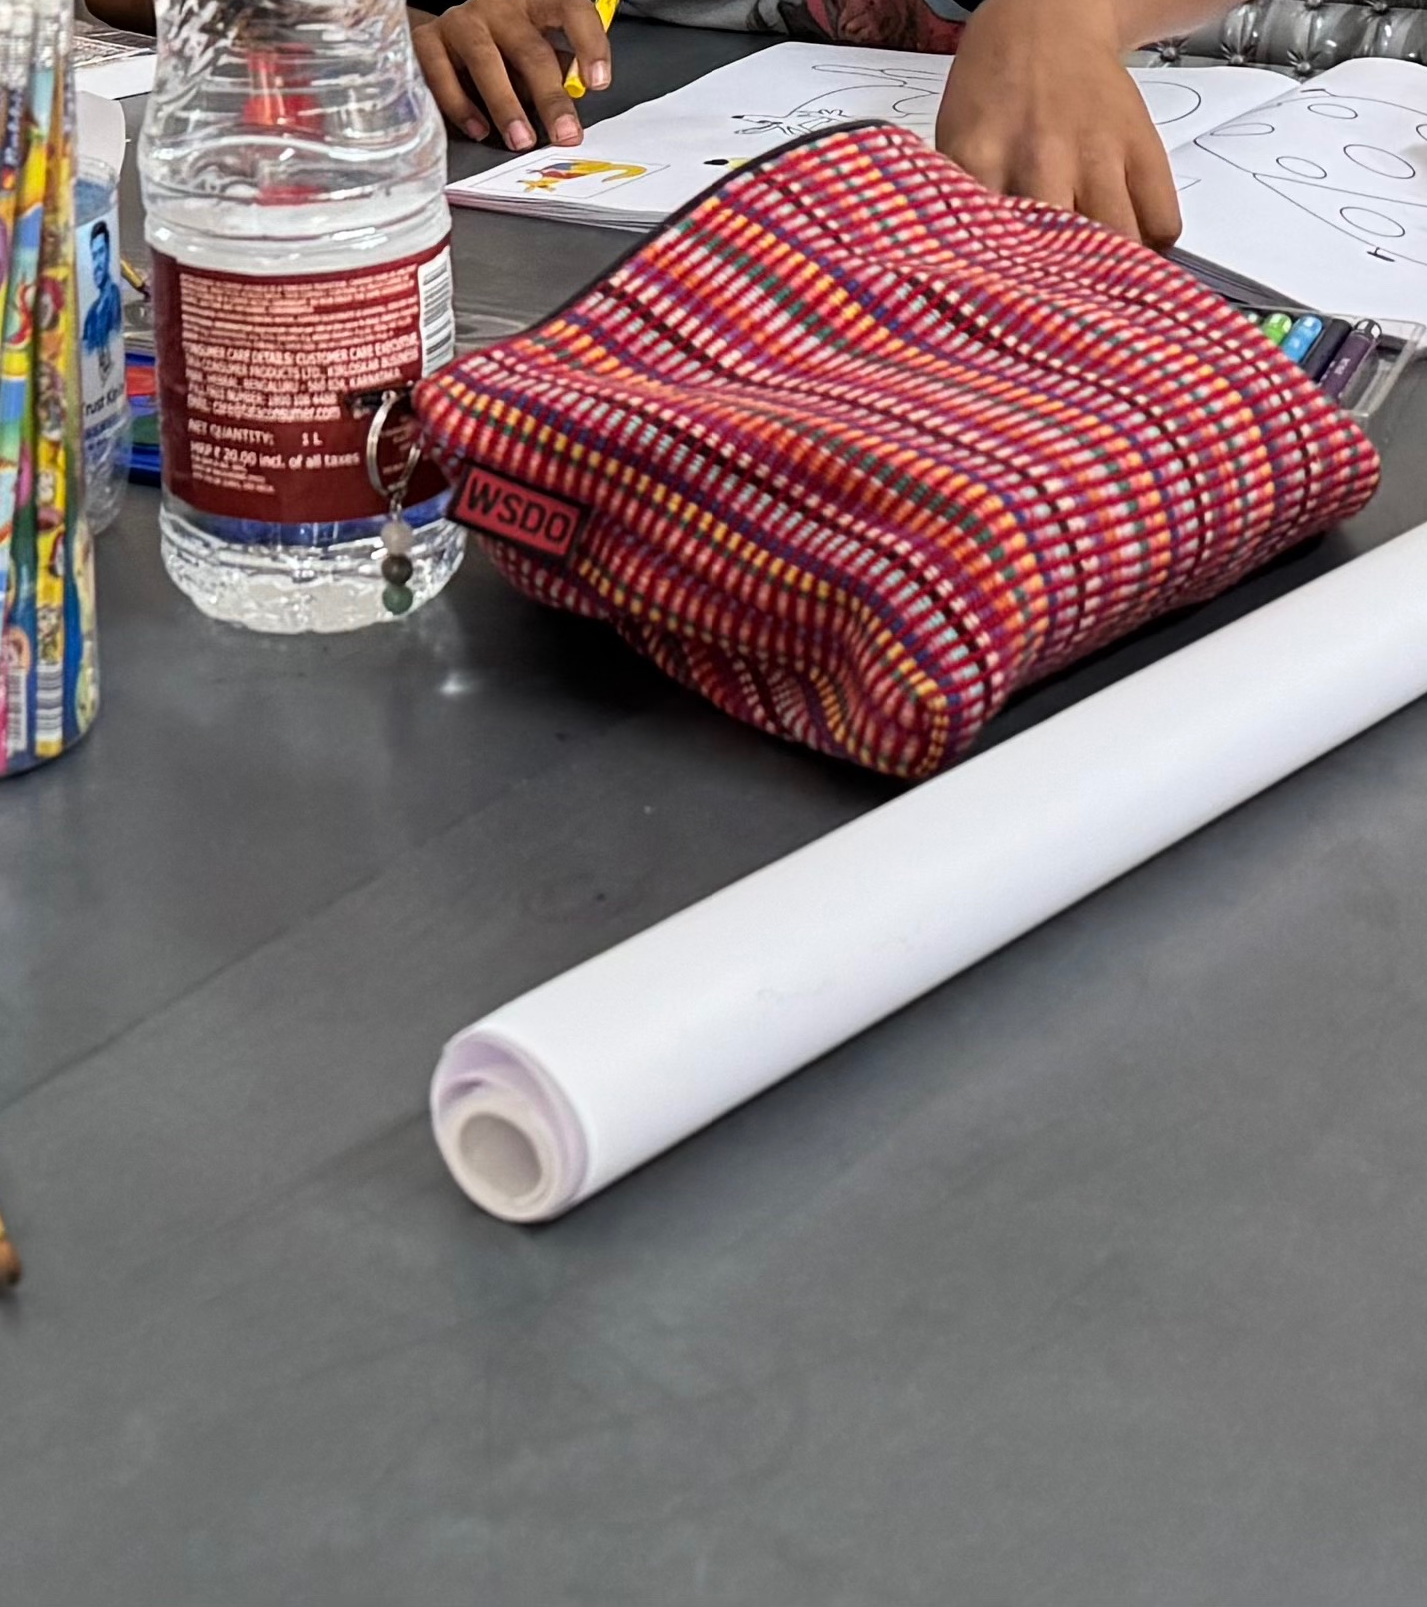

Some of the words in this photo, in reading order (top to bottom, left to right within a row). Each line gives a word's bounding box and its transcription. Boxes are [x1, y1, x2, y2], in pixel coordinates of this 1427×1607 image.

[289, 454, 303, 470] of
[306, 454, 322, 469] all
[324, 452, 360, 467] taxes
[467, 475, 572, 544] WSDO
